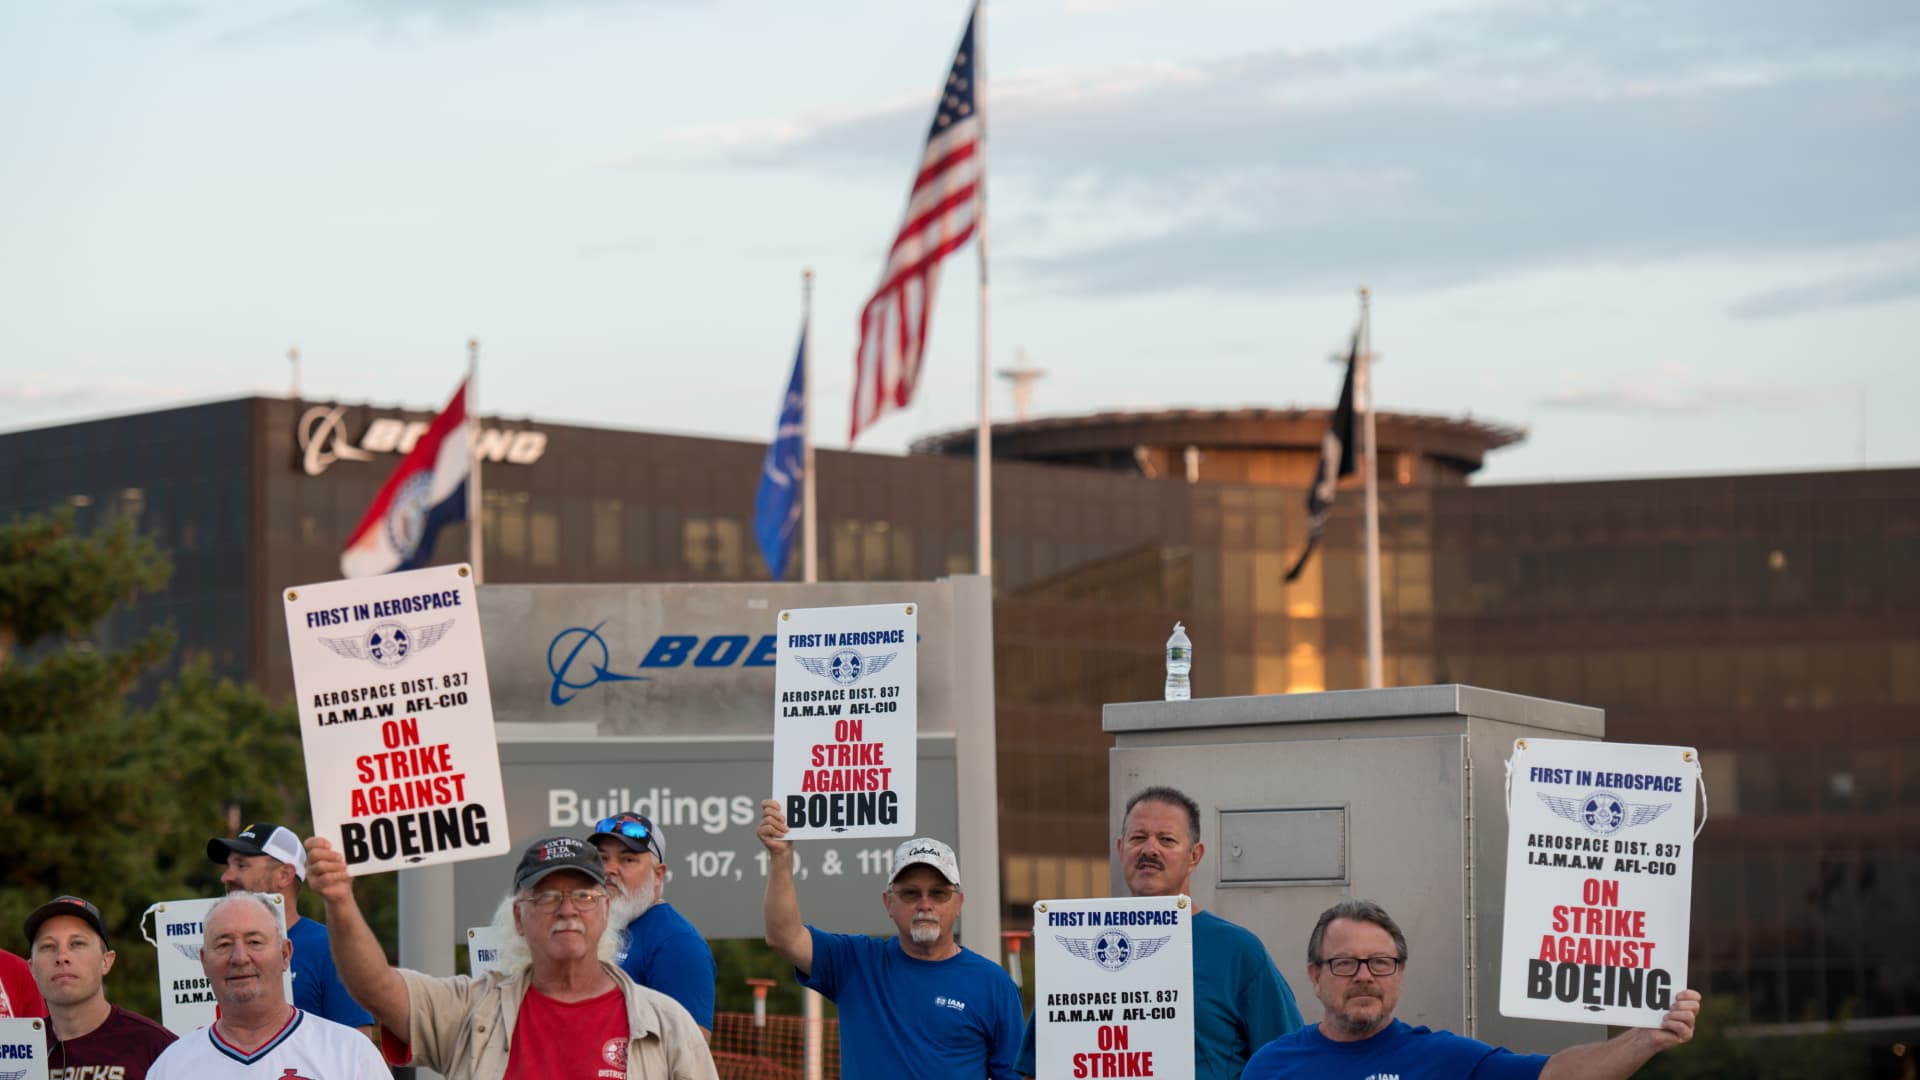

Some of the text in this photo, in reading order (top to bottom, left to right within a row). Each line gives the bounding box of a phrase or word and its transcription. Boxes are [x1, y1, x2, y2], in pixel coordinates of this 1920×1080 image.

[306, 590, 461, 628] FIRST IN AEROSPACE
[789, 629, 904, 648] FIRST IN AEROSPACE
[314, 672, 469, 708] AEROSPACE DIST. 837
[782, 686, 900, 703] AEROSPACE DIST. 837
[318, 691, 468, 726] I.A.M.A.W AFL-CIO
[783, 701, 897, 718] I.A.M.A.W AFL-CIO
[382, 718, 419, 749] ON
[835, 719, 863, 742] ON
[356, 744, 453, 784] STRIKE
[811, 743, 884, 767] STRIKE
[802, 768, 892, 792] AGAINST
[1530, 767, 1682, 793] FIRST IN AEROSPACE
[351, 774, 466, 817] AGAINST
[548, 789, 754, 835] Buildings
[787, 791, 898, 829] BOEING
[340, 803, 490, 865] BOEING
[1528, 834, 1681, 858] AEROSPACE DIST. 837
[685, 851, 742, 881] 107,
[822, 850, 843, 875] &
[1528, 852, 1676, 875] I.A.M.A.W AFL-CIO
[1583, 878, 1619, 907] ON
[166, 923, 197, 937] FIRST
[1048, 911, 1178, 927] FIRST IN AEROSPACE
[1552, 905, 1646, 938] STRIKE
[1539, 935, 1656, 969] AGAINST
[1527, 958, 1672, 1011] BOEING
[175, 992, 217, 1004] I.A.M.A.
[948, 998, 965, 1009] IAM
[1048, 990, 1178, 1006] AEROSPACE DIST. 837
[1049, 1007, 1176, 1023] I.A.M.A.W AFL-CIO
[1097, 1025, 1129, 1051] ON
[1073, 1051, 1154, 1079] STRIKE
